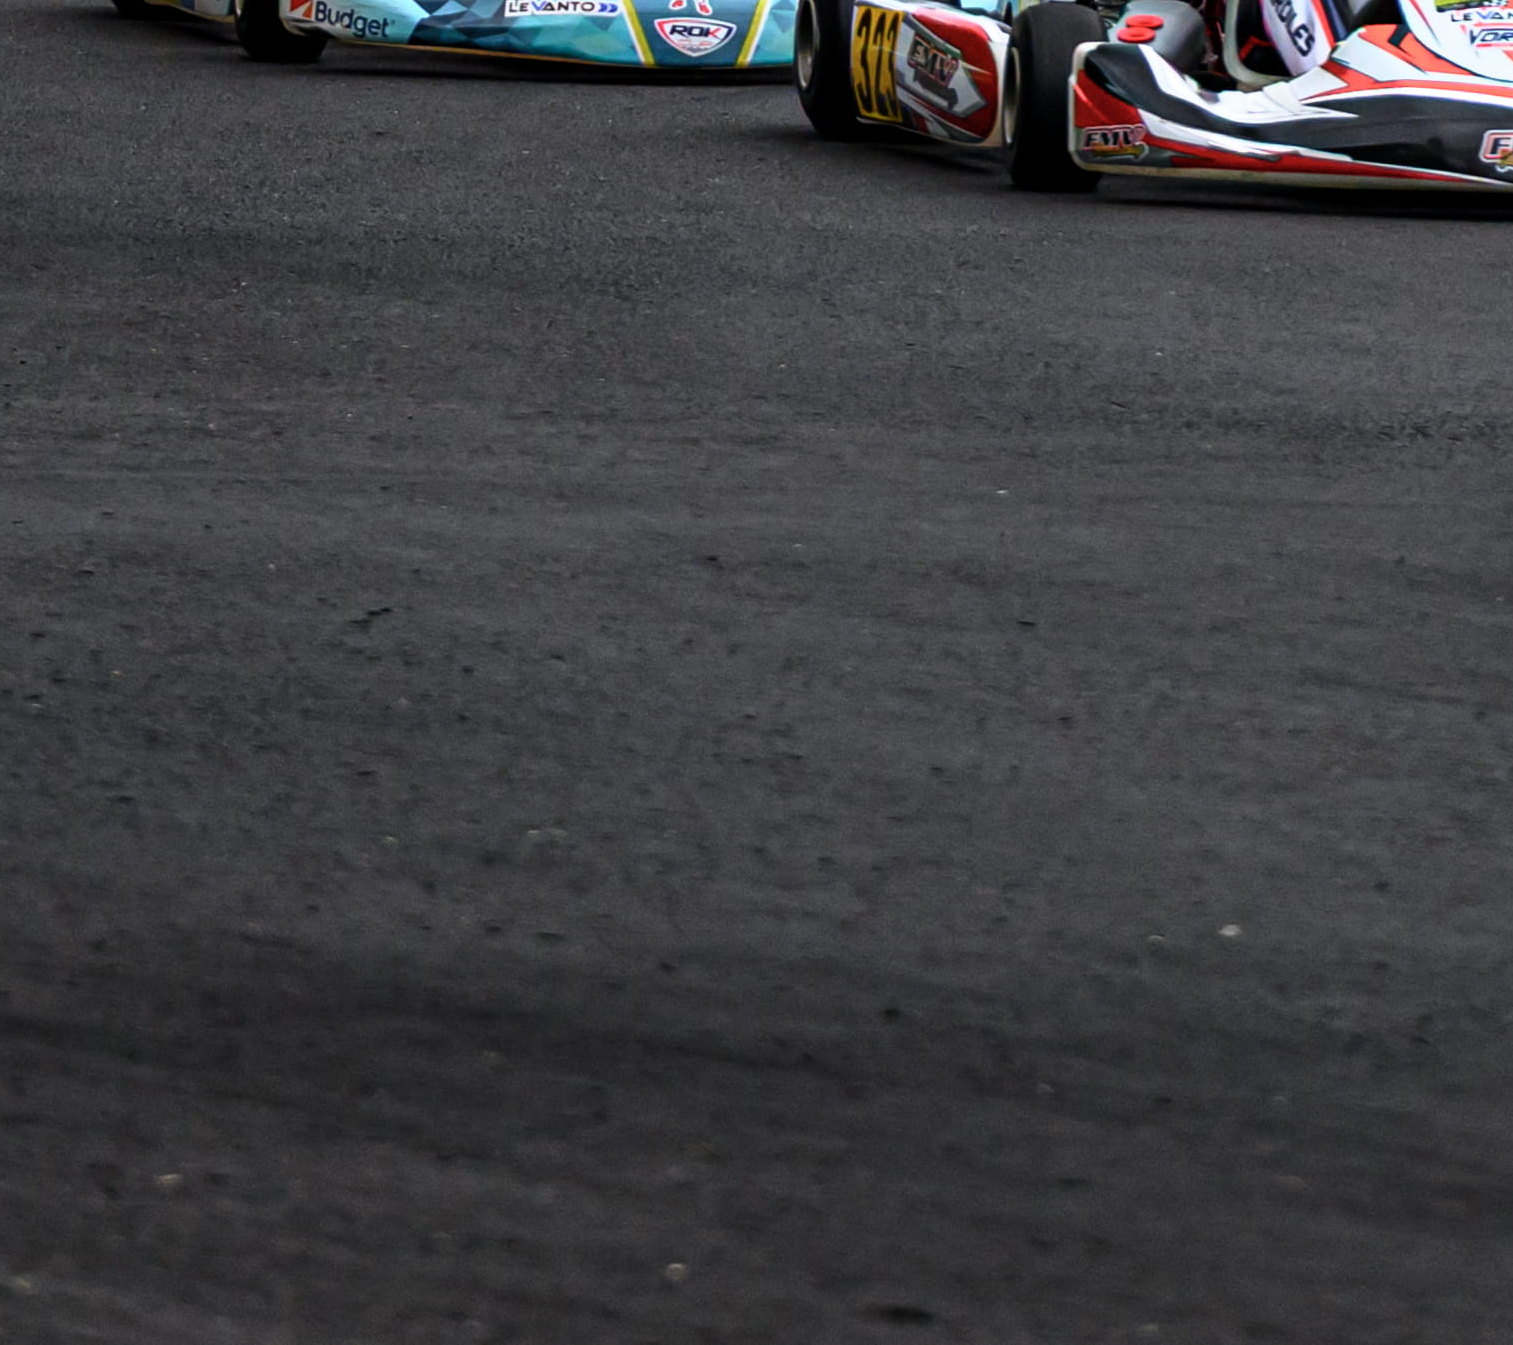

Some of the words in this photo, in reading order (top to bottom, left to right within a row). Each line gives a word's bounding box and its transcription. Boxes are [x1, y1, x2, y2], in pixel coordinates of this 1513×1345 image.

[508, 0, 596, 13] LEVANTO
[314, 0, 391, 40] Budget
[669, 24, 723, 41] ROK
